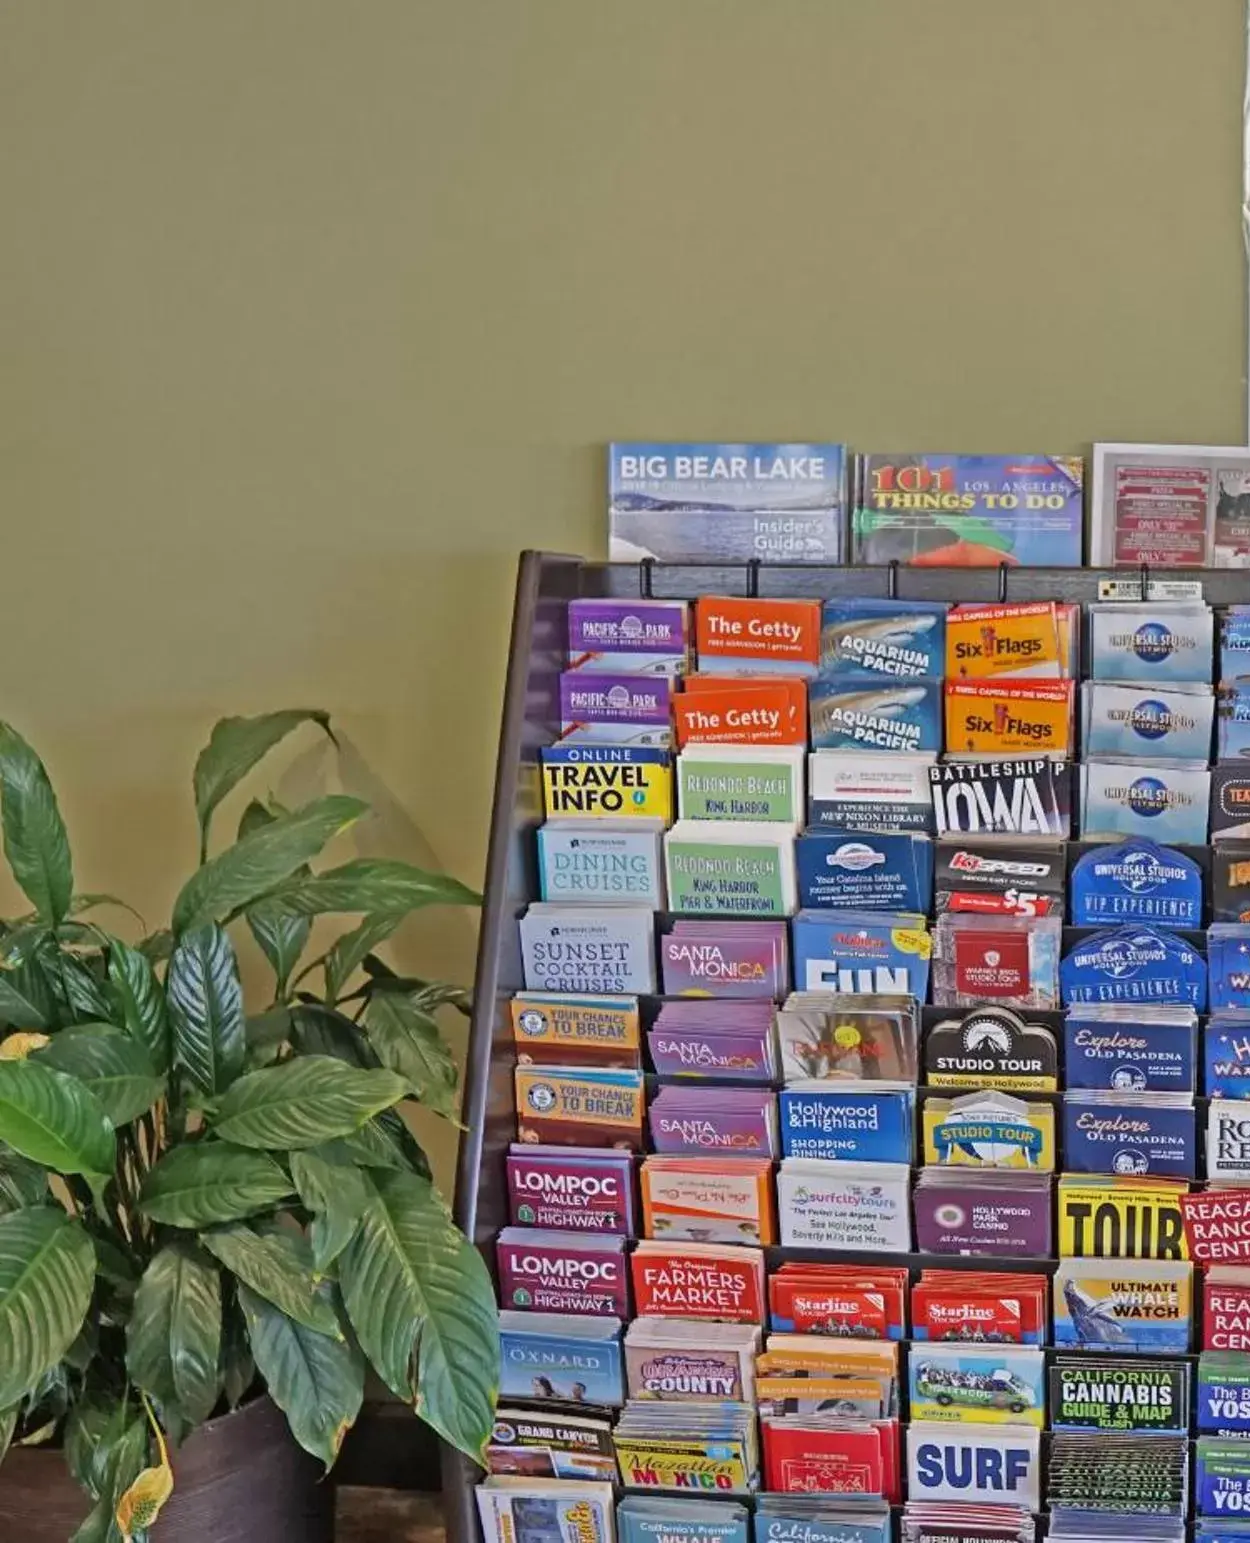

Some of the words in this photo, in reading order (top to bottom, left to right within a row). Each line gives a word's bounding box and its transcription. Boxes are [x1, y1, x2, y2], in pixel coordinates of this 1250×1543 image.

[620, 457, 667, 478] BIG
[675, 457, 748, 479] BEAR
[755, 457, 825, 479] LAKE
[964, 482, 990, 492] LOS
[1002, 481, 1067, 493] ANGELES
[873, 492, 976, 509] THINGS
[985, 495, 1017, 509] TO
[1025, 495, 1065, 509] DO
[708, 616, 741, 635] The
[748, 618, 800, 641] Getty
[840, 635, 929, 667] AQUARIUM
[955, 638, 982, 658] Six
[996, 637, 1042, 656] Flags
[685, 712, 719, 729] The
[725, 708, 779, 731] Getty
[568, 750, 631, 761] ONLINE
[547, 766, 649, 787] TRAVEL
[552, 790, 623, 811] INFO
[933, 777, 1049, 834] IOWA
[821, 812, 840, 822] NEW
[842, 814, 878, 823] NIXON
[881, 815, 926, 824] LIBRARY
[554, 853, 648, 872] DINING
[1095, 865, 1147, 878] UNIVERSAL
[1150, 867, 1187, 880] STUDIOS
[553, 873, 650, 893] CRUISES
[1085, 897, 1108, 912] VIP
[1114, 897, 1193, 916] EXPERIENCE
[533, 942, 630, 961] SUNSET
[669, 945, 723, 961] SANTA
[1074, 951, 1125, 968] UNIVERSAL
[1127, 949, 1166, 962] STUDIOS
[534, 962, 632, 976] COCKTAIL
[690, 962, 765, 978] MONICA
[551, 1009, 580, 1022] YOUR
[583, 1010, 626, 1025] CHANCE
[554, 1021, 572, 1035] TO
[575, 1022, 626, 1038] BREAK
[657, 1040, 713, 1056] SANTA
[1075, 1030, 1148, 1051] Explore
[1084, 1048, 1113, 1059] OLD
[1116, 1049, 1182, 1061] PASADENA
[938, 1058, 994, 1070] STUDIO
[1001, 1059, 1042, 1071] TOUR
[936, 1077, 979, 1087] Welcome
[981, 1079, 992, 1087] to
[995, 1079, 1045, 1089] Hollywood
[560, 1084, 588, 1097] YOUR
[590, 1087, 635, 1102] CHANCE
[562, 1096, 583, 1110] TO
[585, 1098, 635, 1117] BREAK
[789, 1115, 878, 1132] &Highland
[940, 1125, 993, 1139] STUDIO
[999, 1128, 1034, 1143] TOUR
[1087, 1131, 1115, 1142] OLD
[1119, 1133, 1185, 1145] PASADENA
[790, 1139, 856, 1150] SHOPPING
[792, 1149, 836, 1159] DINING
[514, 1169, 618, 1196] LOMPOC
[542, 1194, 590, 1207] VALLEY
[537, 1210, 605, 1228] HIGHWAY
[608, 1215, 617, 1229] 1
[972, 1214, 999, 1223] PARK
[972, 1221, 1009, 1231] CASINO
[1066, 1203, 1182, 1259] TOUR
[510, 1253, 617, 1280] LOMPOC
[539, 1278, 589, 1290] VALLEY
[644, 1269, 746, 1290] FARMERS
[1111, 1281, 1177, 1293] ULTIMATE
[652, 1287, 742, 1306] MARKET
[1112, 1293, 1178, 1305] WHALE
[1113, 1306, 1179, 1318] WATCH
[645, 1377, 735, 1394] COUNTY
[1061, 1371, 1172, 1385] CALIFORNIA
[1063, 1383, 1172, 1405] CANNABIS
[1213, 1386, 1239, 1400] The
[1063, 1403, 1110, 1417] GUIDE
[1115, 1405, 1129, 1419] &
[1133, 1405, 1172, 1420] MAP
[517, 1426, 554, 1439] GRAND
[556, 1429, 599, 1444] CANYON
[916, 1444, 1031, 1491] SURF
[1217, 1477, 1243, 1491] The
